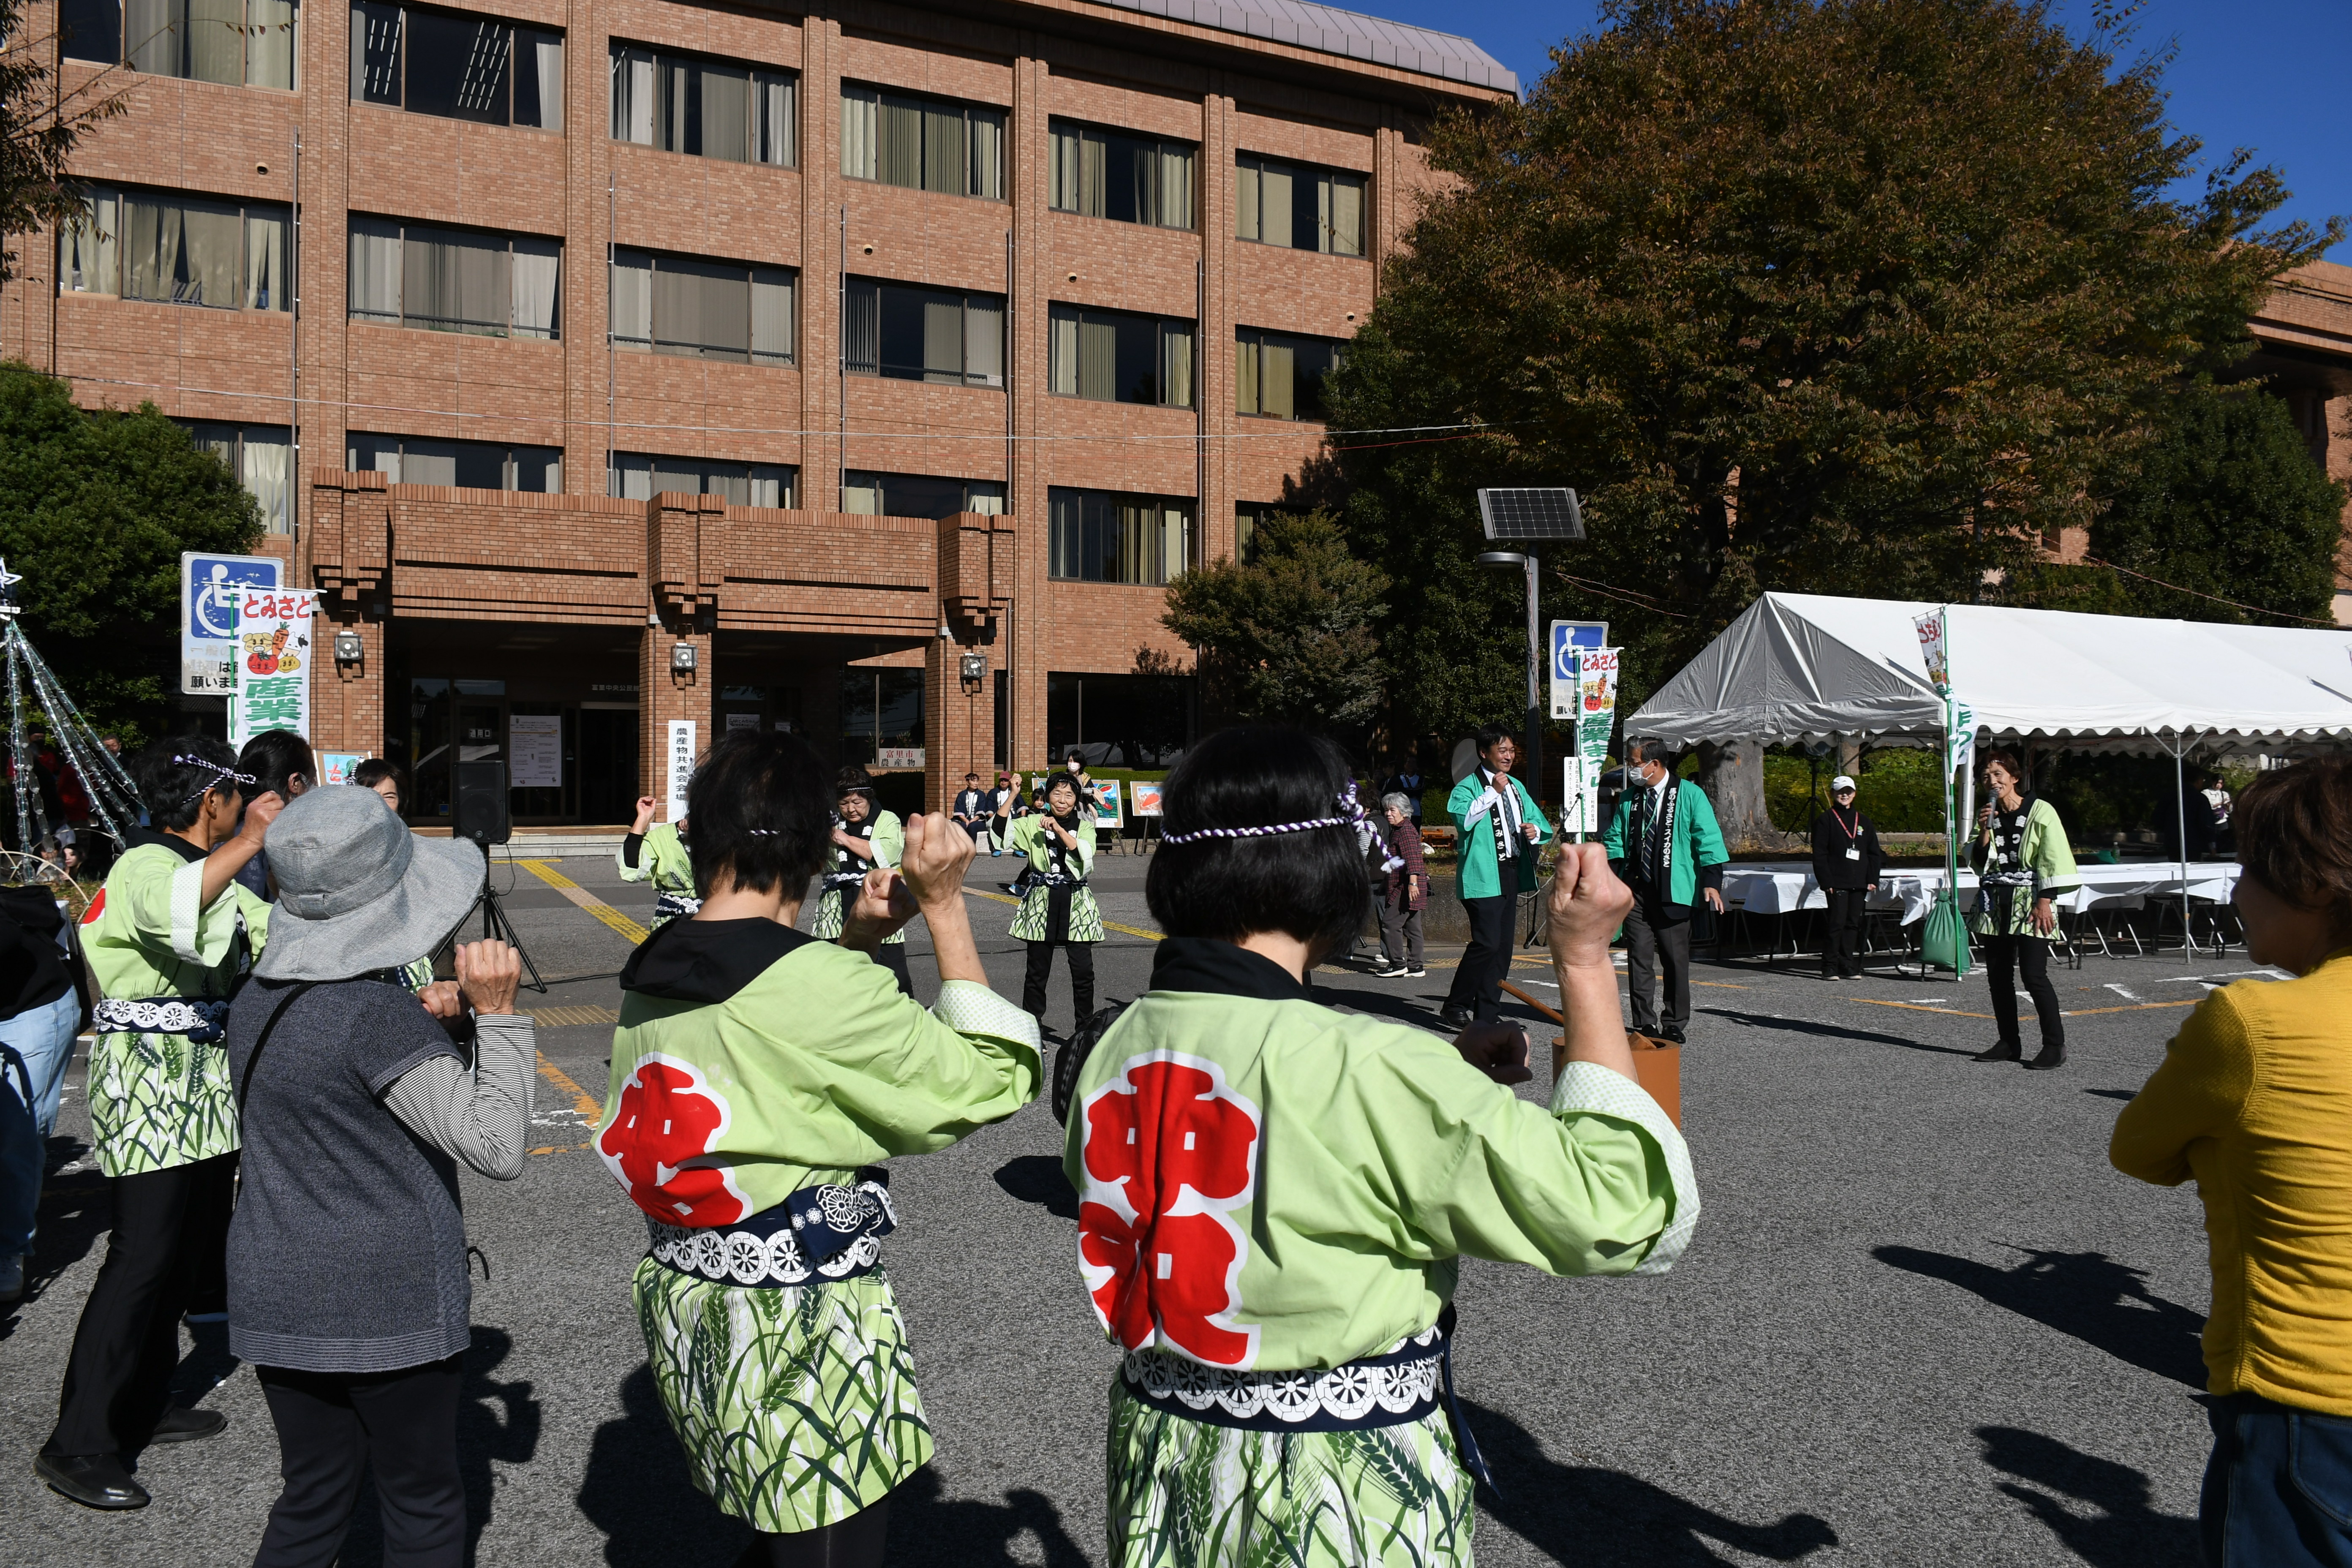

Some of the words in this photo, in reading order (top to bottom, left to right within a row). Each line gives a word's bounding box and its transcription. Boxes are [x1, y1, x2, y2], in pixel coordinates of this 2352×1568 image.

[244, 594, 310, 620] とみさと
[1582, 653, 1617, 672] とみさと
[470, 729, 490, 738] 通用口
[881, 758, 915, 767] 農産物
[886, 750, 913, 758] 富里市
[675, 728, 688, 801] 農産物共進会会場
[1484, 785, 1506, 861] ・とみさと
